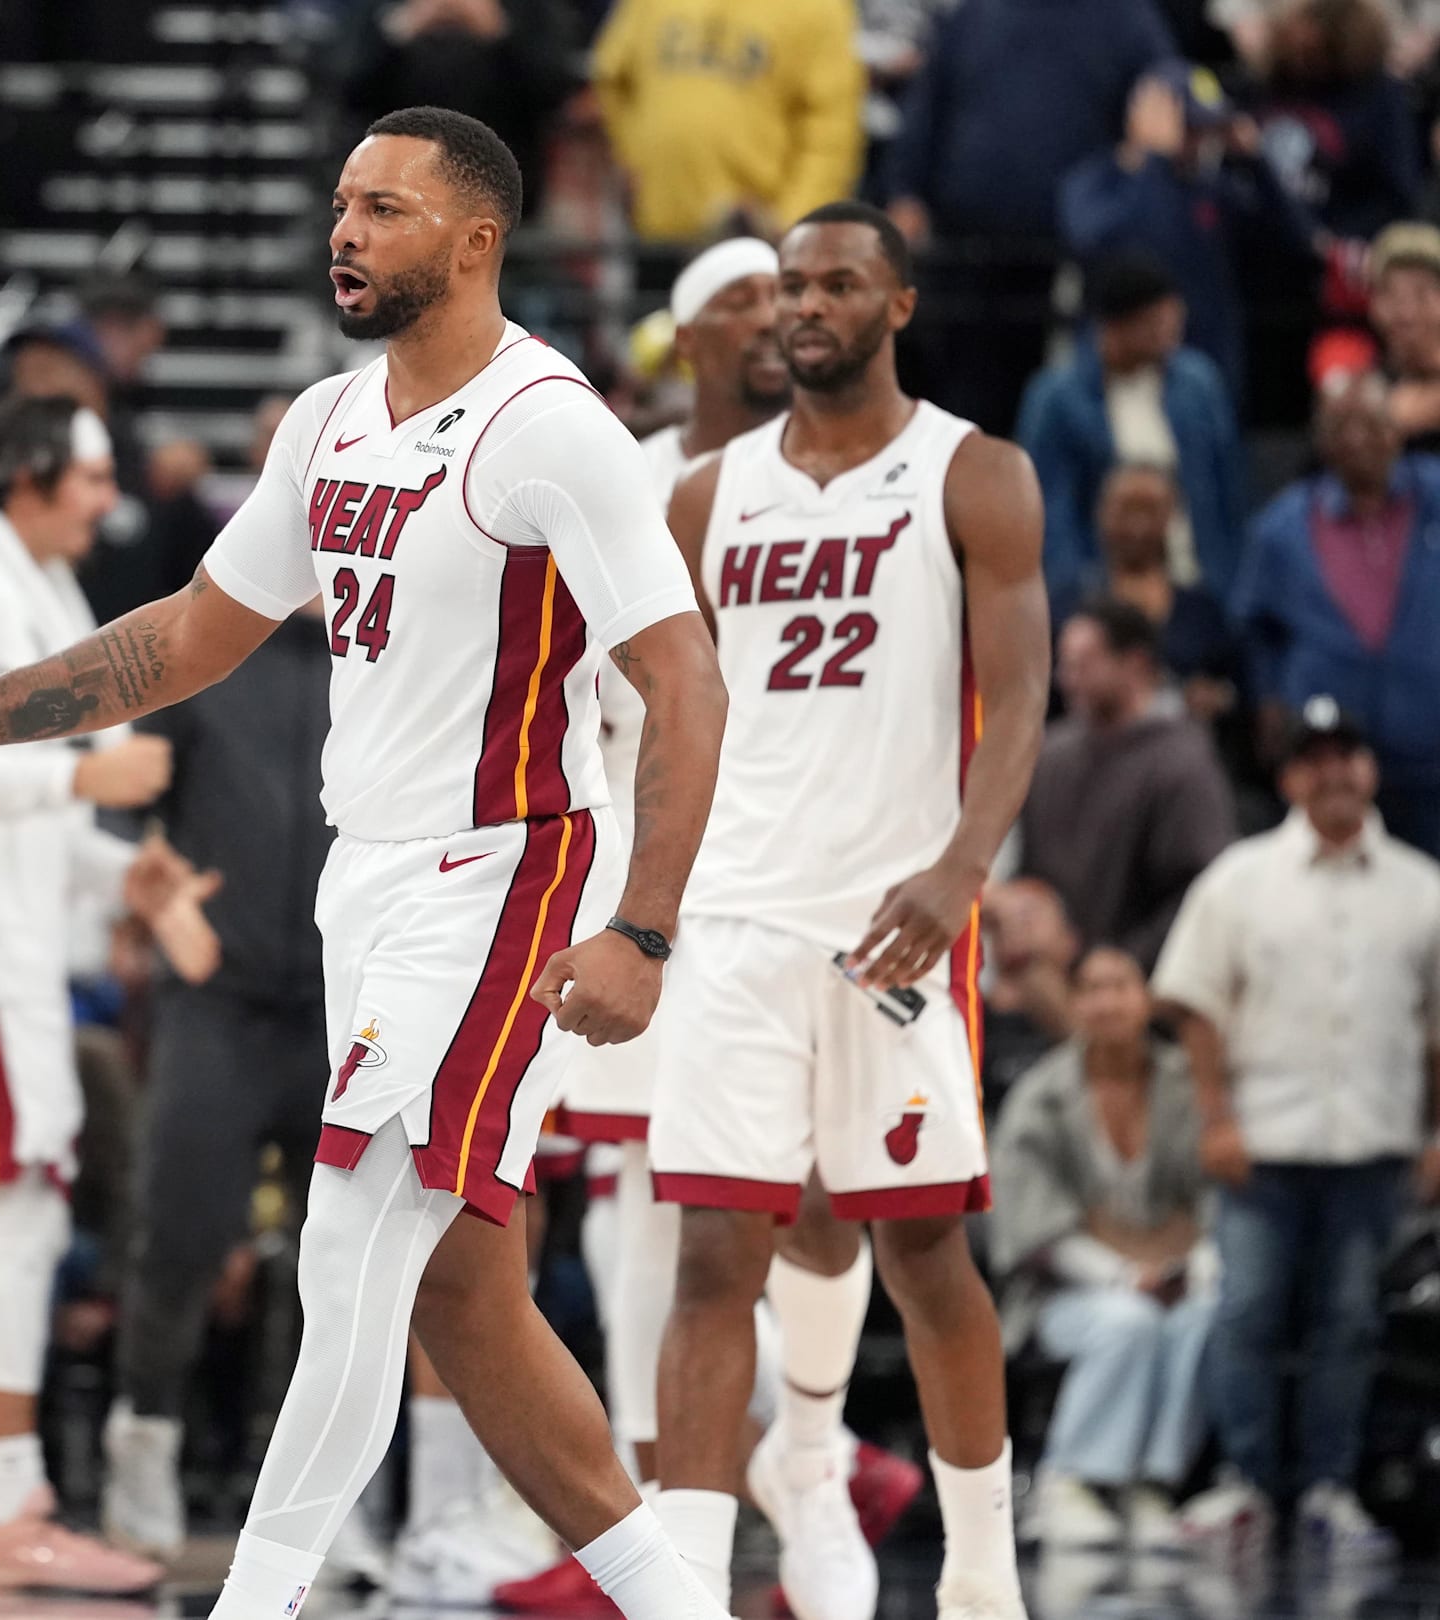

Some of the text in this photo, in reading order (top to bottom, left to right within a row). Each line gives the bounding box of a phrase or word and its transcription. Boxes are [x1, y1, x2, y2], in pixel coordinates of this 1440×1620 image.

[414, 440, 456, 458] Robinhood
[308, 463, 447, 560] HEAT
[720, 511, 911, 608] HEAT
[330, 567, 396, 663] 24
[766, 611, 878, 692] 22
